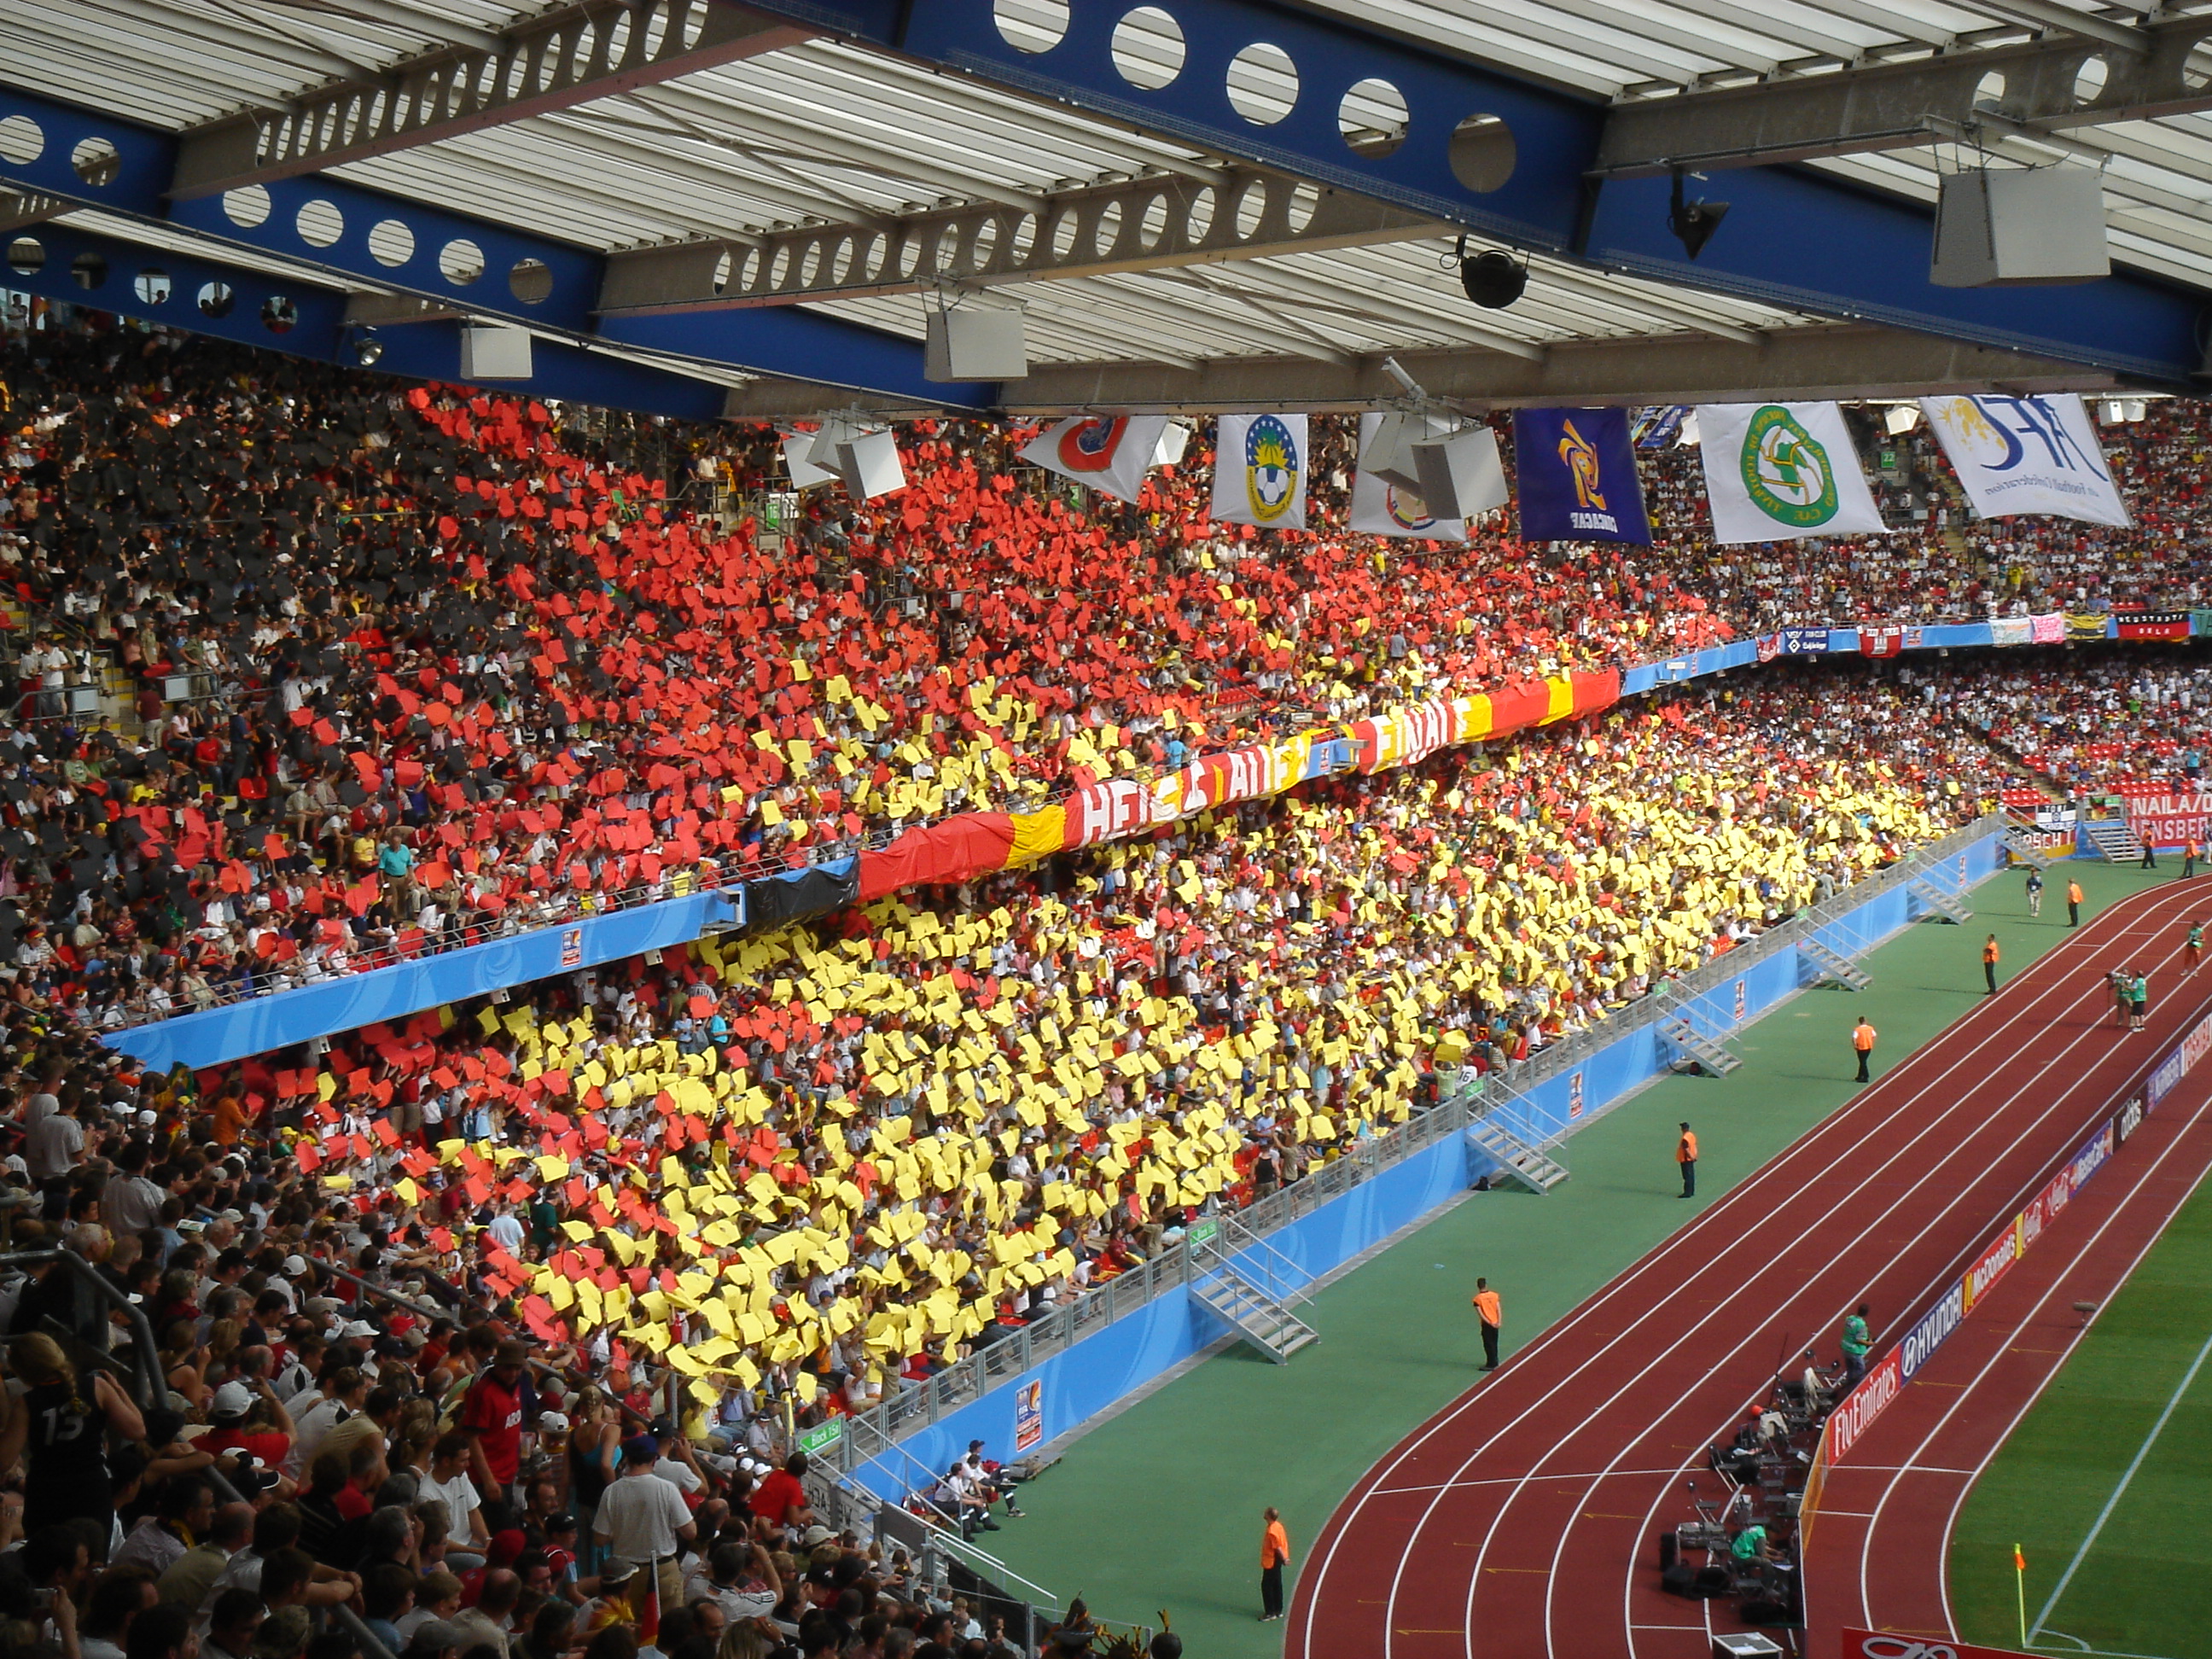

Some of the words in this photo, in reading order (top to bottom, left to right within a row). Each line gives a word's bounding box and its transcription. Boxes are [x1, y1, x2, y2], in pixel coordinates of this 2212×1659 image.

[1459, 1071, 1471, 1082] 16
[42, 1401, 84, 1447] 13
[1835, 1409, 1853, 1458] Fly
[1853, 1362, 1897, 1437] Emirates
